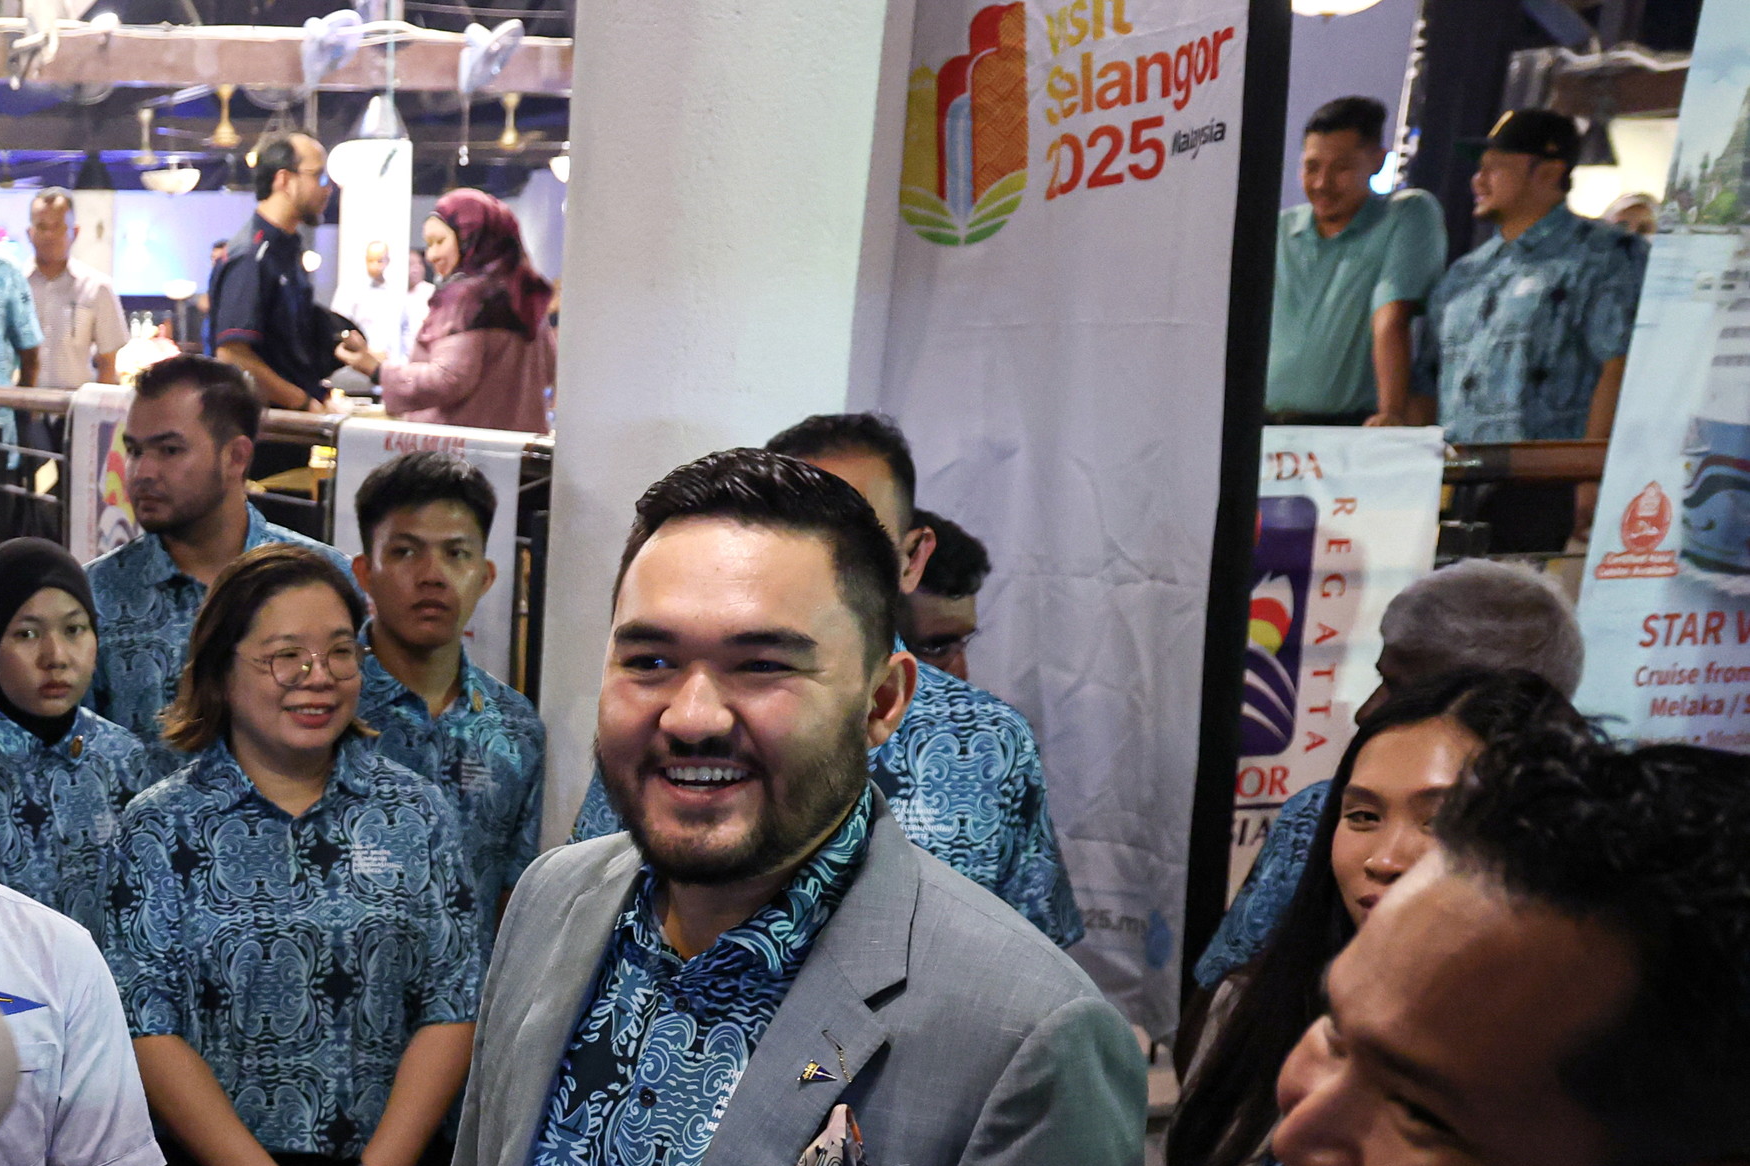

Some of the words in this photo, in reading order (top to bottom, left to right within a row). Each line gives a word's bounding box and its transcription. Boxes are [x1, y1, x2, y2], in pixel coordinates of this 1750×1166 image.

[1304, 497, 1358, 754] REGATTA
[1638, 610, 1726, 648] STAR
[1635, 662, 1700, 687] Cruise
[1650, 693, 1725, 717] Melaka
